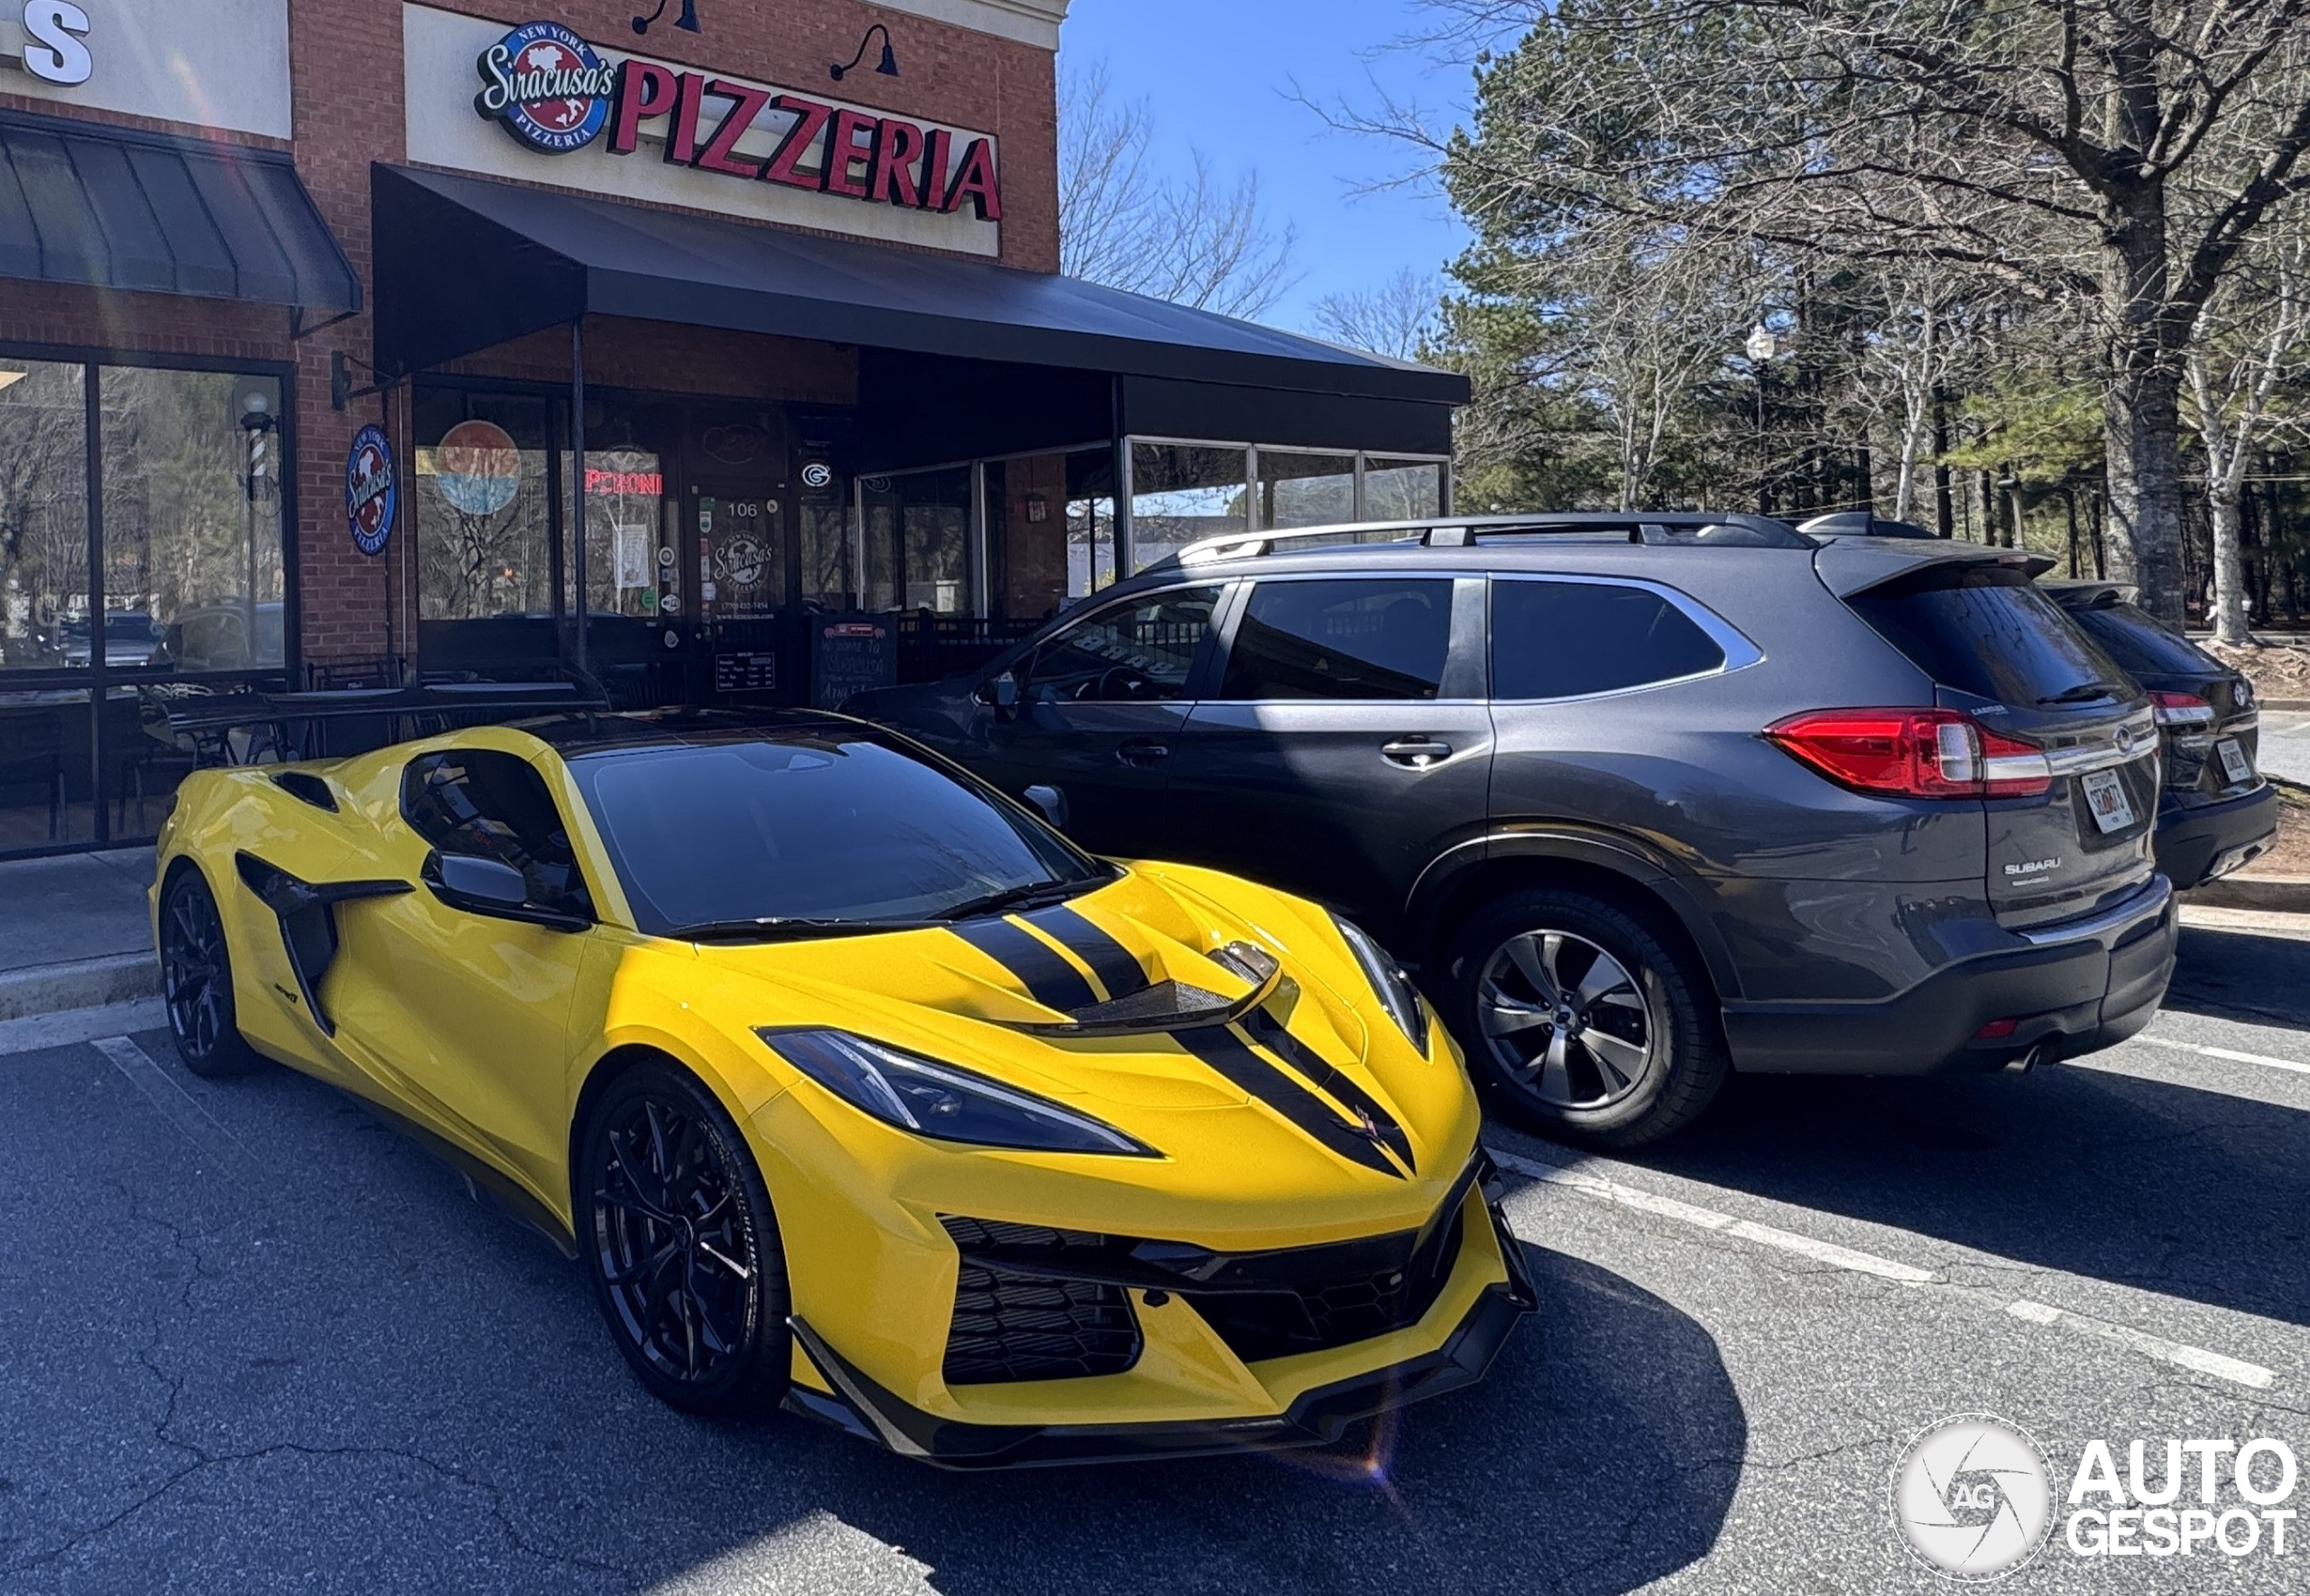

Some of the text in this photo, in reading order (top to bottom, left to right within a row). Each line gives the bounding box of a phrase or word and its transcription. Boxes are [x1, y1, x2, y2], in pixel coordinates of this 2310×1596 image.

[23, 0, 92, 86] S
[518, 24, 588, 58] NEW YORK
[485, 43, 614, 109] Siracusa's
[515, 114, 592, 148] PIZZERIA
[608, 60, 1002, 221] PIZZERIA
[367, 430, 386, 451] YORK
[585, 468, 663, 494] PERONI
[728, 503, 758, 518] 106
[714, 542, 772, 580] Siracusa's
[2004, 857, 2061, 875] SUBARU
